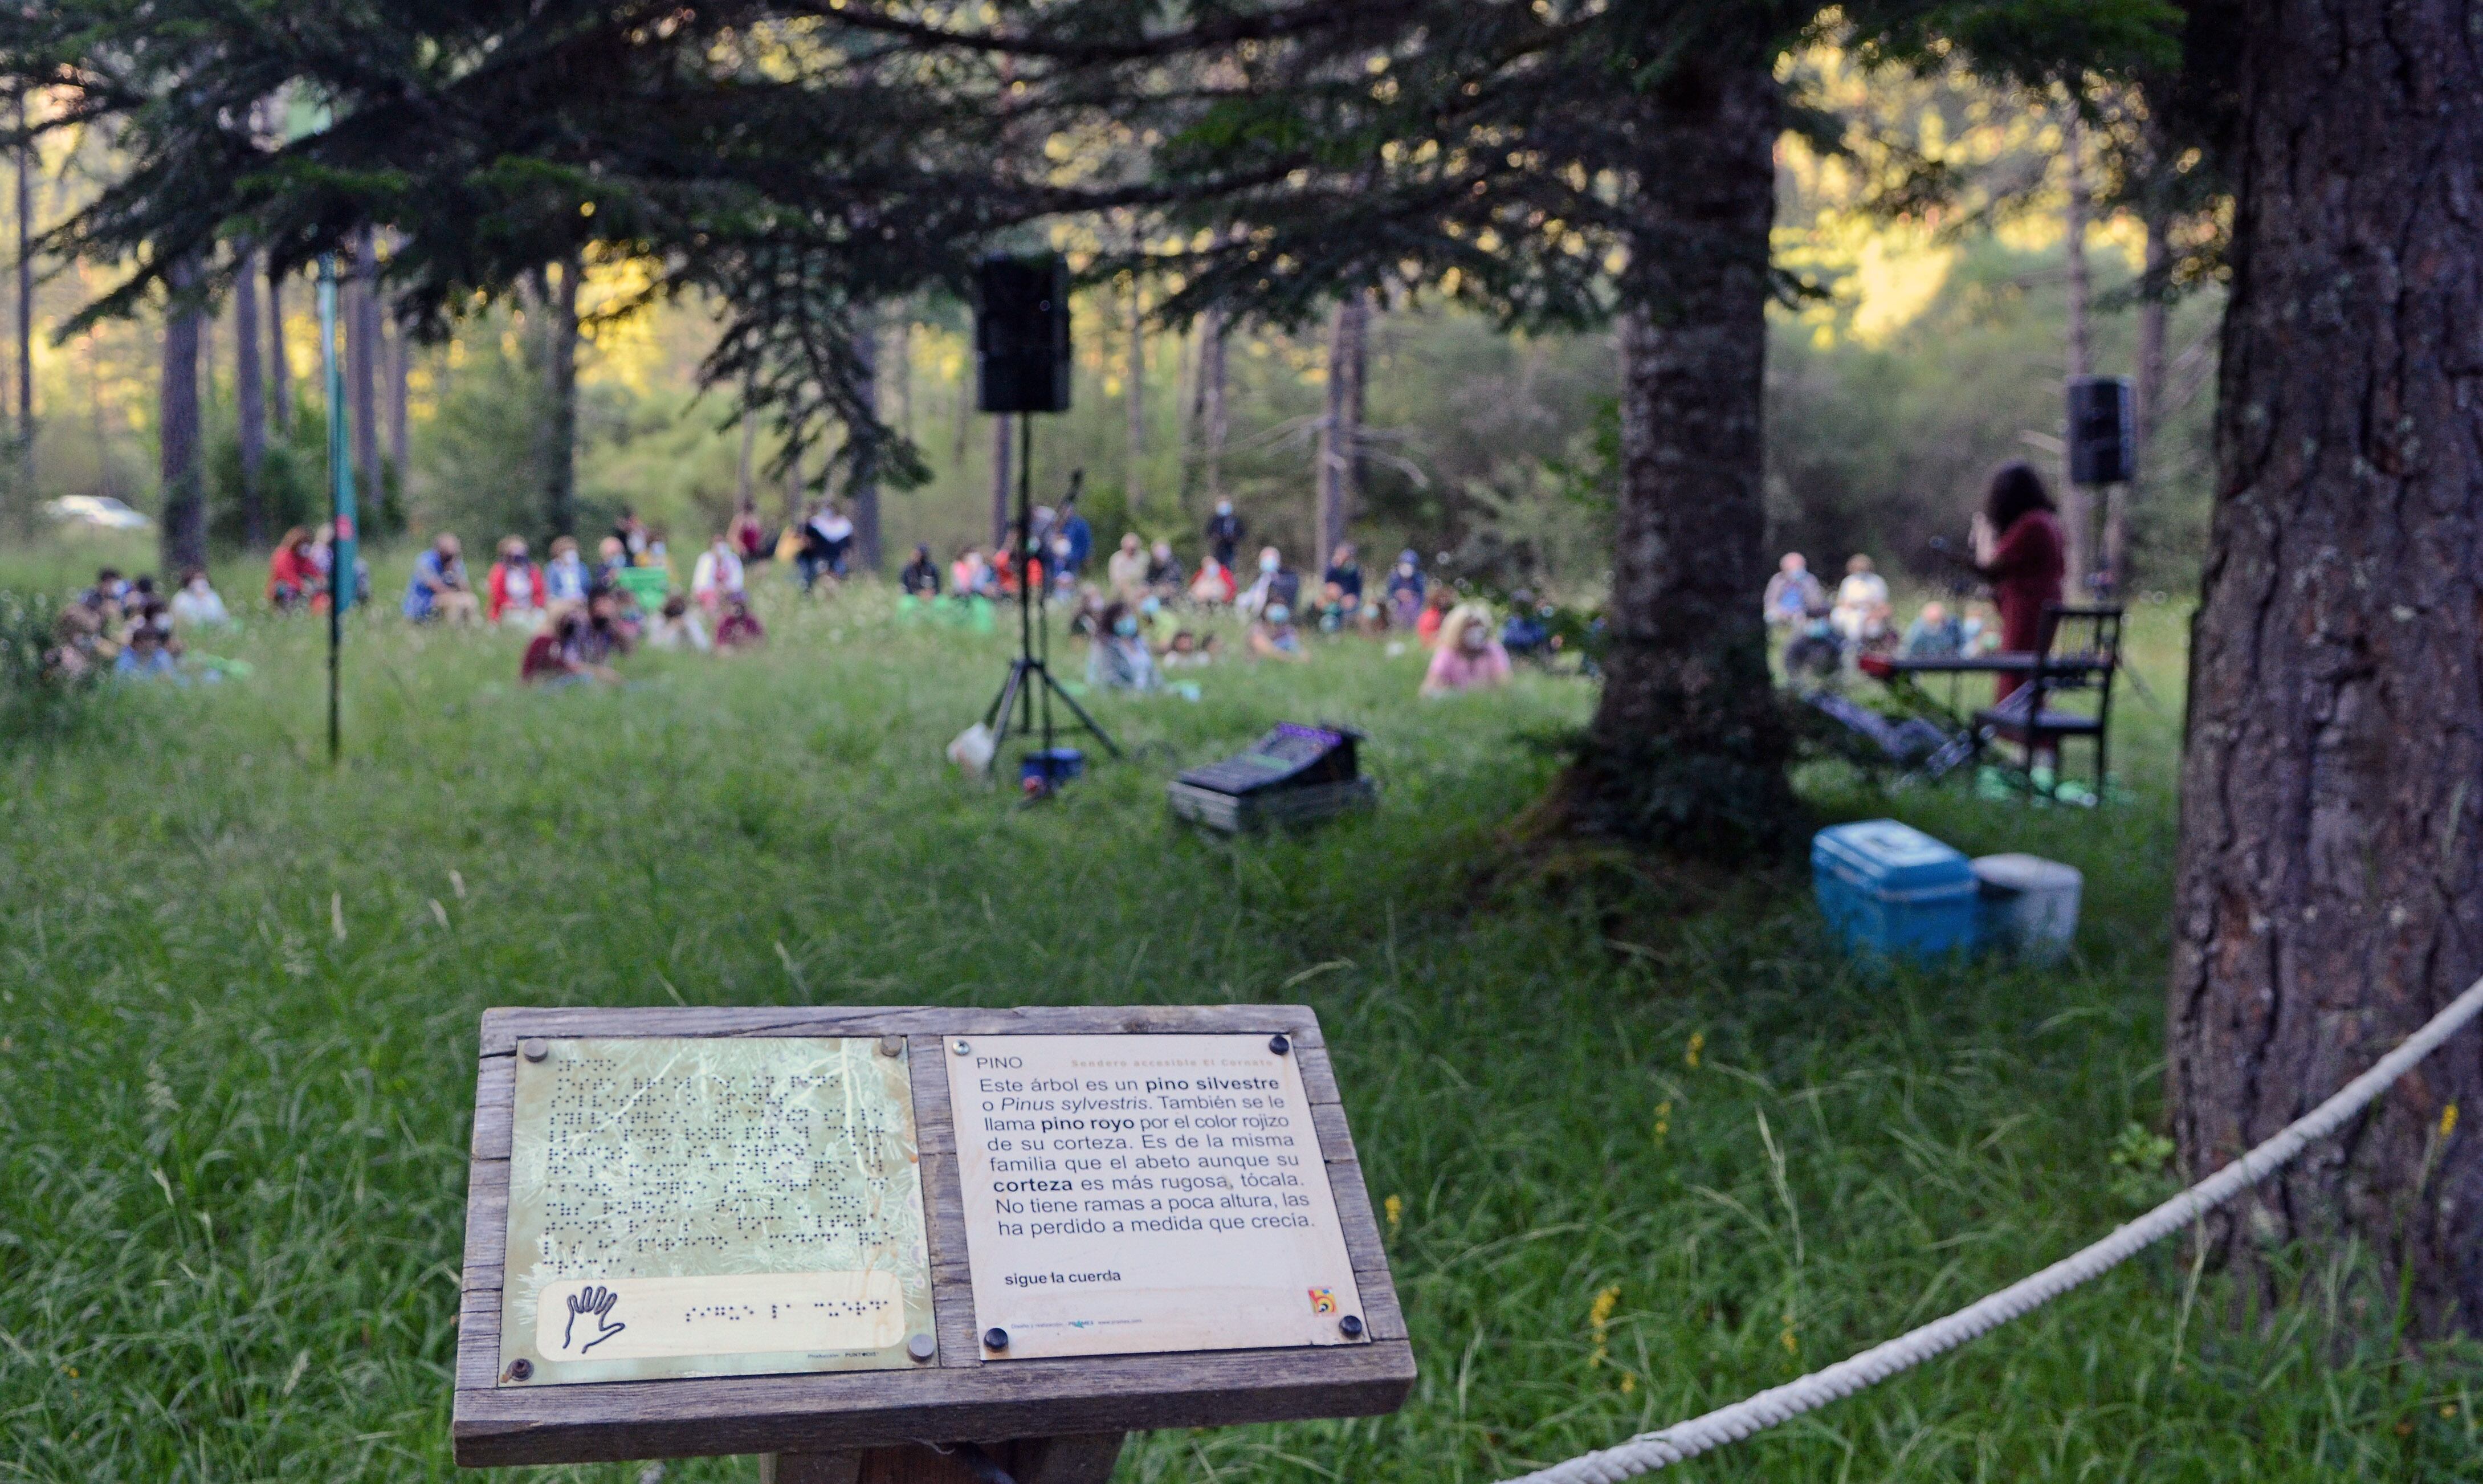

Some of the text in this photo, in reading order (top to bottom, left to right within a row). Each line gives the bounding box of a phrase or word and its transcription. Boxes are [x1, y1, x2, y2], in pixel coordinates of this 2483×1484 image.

[976, 1056, 1023, 1069] PINO
[979, 1077, 1279, 1092] Este árbol es un pino silvestre
[982, 1095, 1285, 1113] o Pinus sylvestris. También se le
[984, 1115, 1289, 1132] llama pino royo por el color rojizo
[987, 1133, 1295, 1152] de su corteza. Es de la misma
[989, 1154, 1299, 1172] familia que el abeto aunque su
[993, 1172, 1304, 1193] corteza es más rugosa, tócala.
[995, 1192, 1310, 1214] No tiene ramas a poca altura, las
[998, 1220, 1024, 1236] ha
[1030, 1218, 1106, 1239] perdido
[1112, 1220, 1124, 1233] a
[1131, 1216, 1204, 1232] medida
[1209, 1217, 1245, 1233] que
[1005, 1269, 1122, 1287] sigue la cuerda
